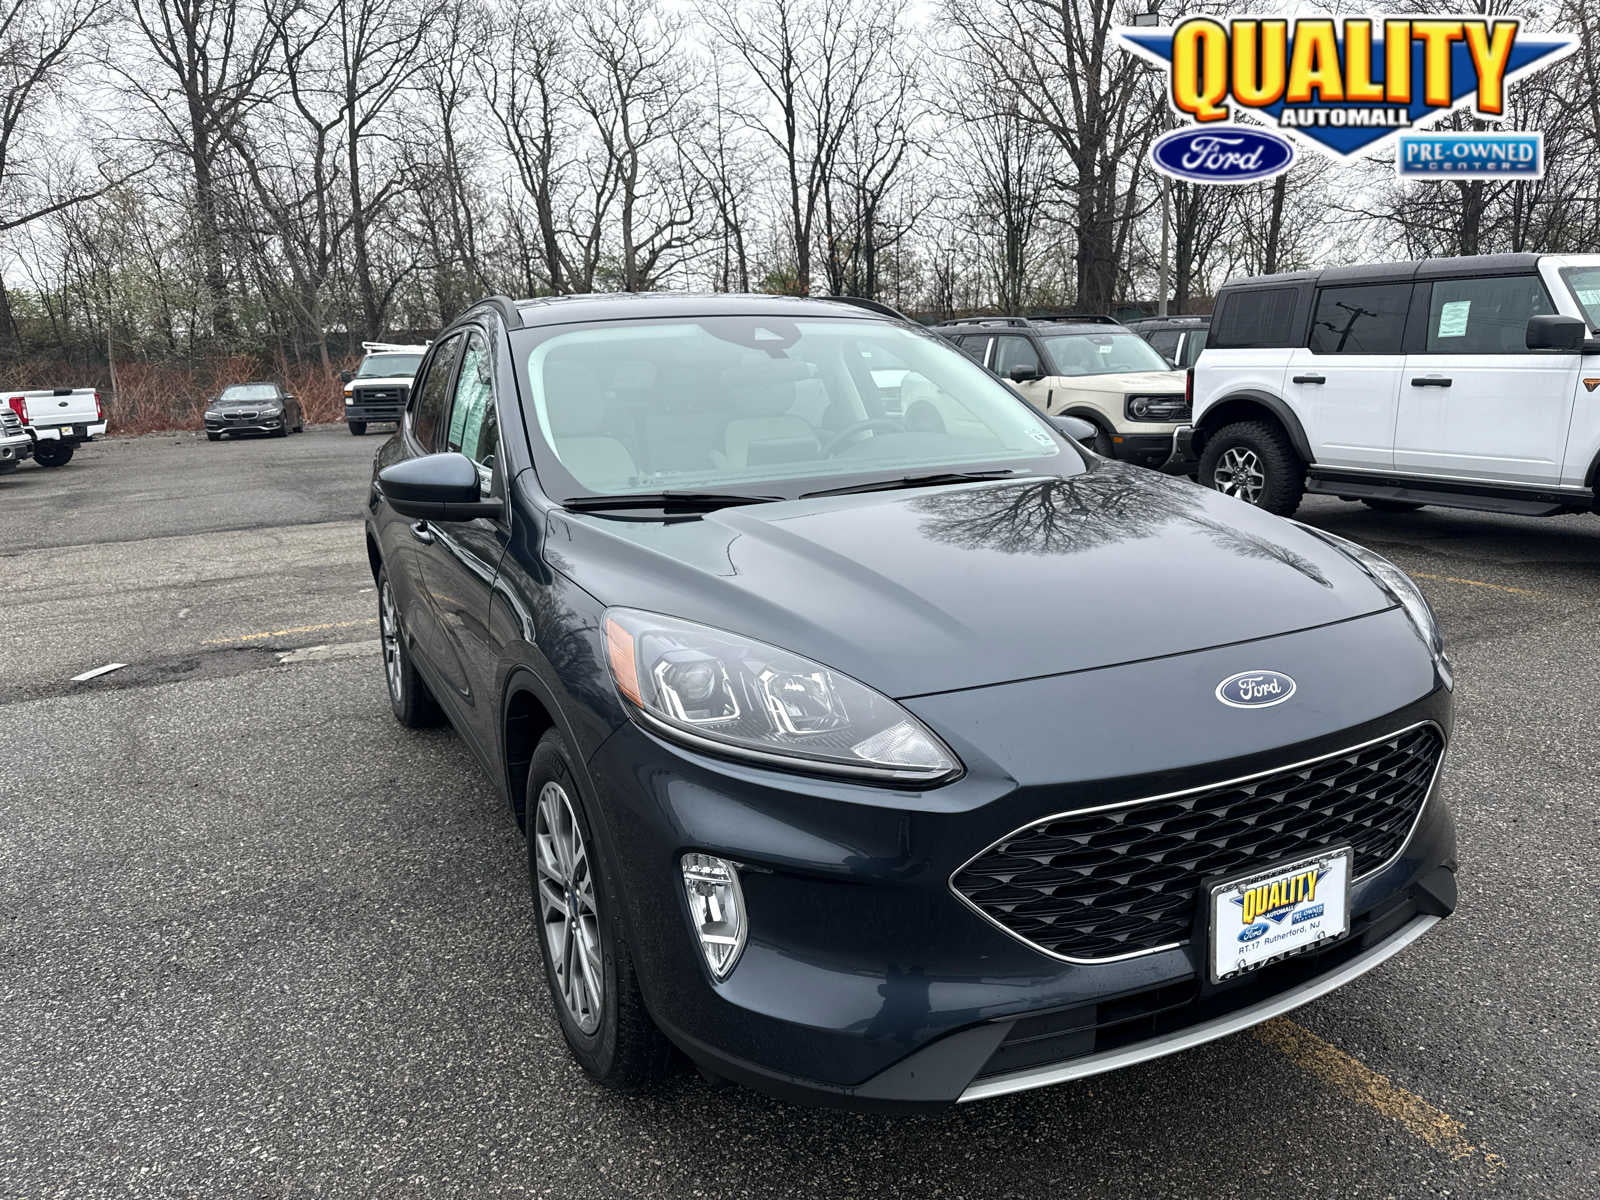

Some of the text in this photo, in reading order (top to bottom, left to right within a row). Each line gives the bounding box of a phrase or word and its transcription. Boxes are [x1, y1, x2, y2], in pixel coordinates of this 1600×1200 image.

[1238, 676, 1281, 700] Ford
[1242, 869, 1319, 924] QUALITY
[1243, 926, 1264, 940] Ford
[1264, 926, 1307, 944] Rutherford,
[1310, 921, 1320, 929] NJ
